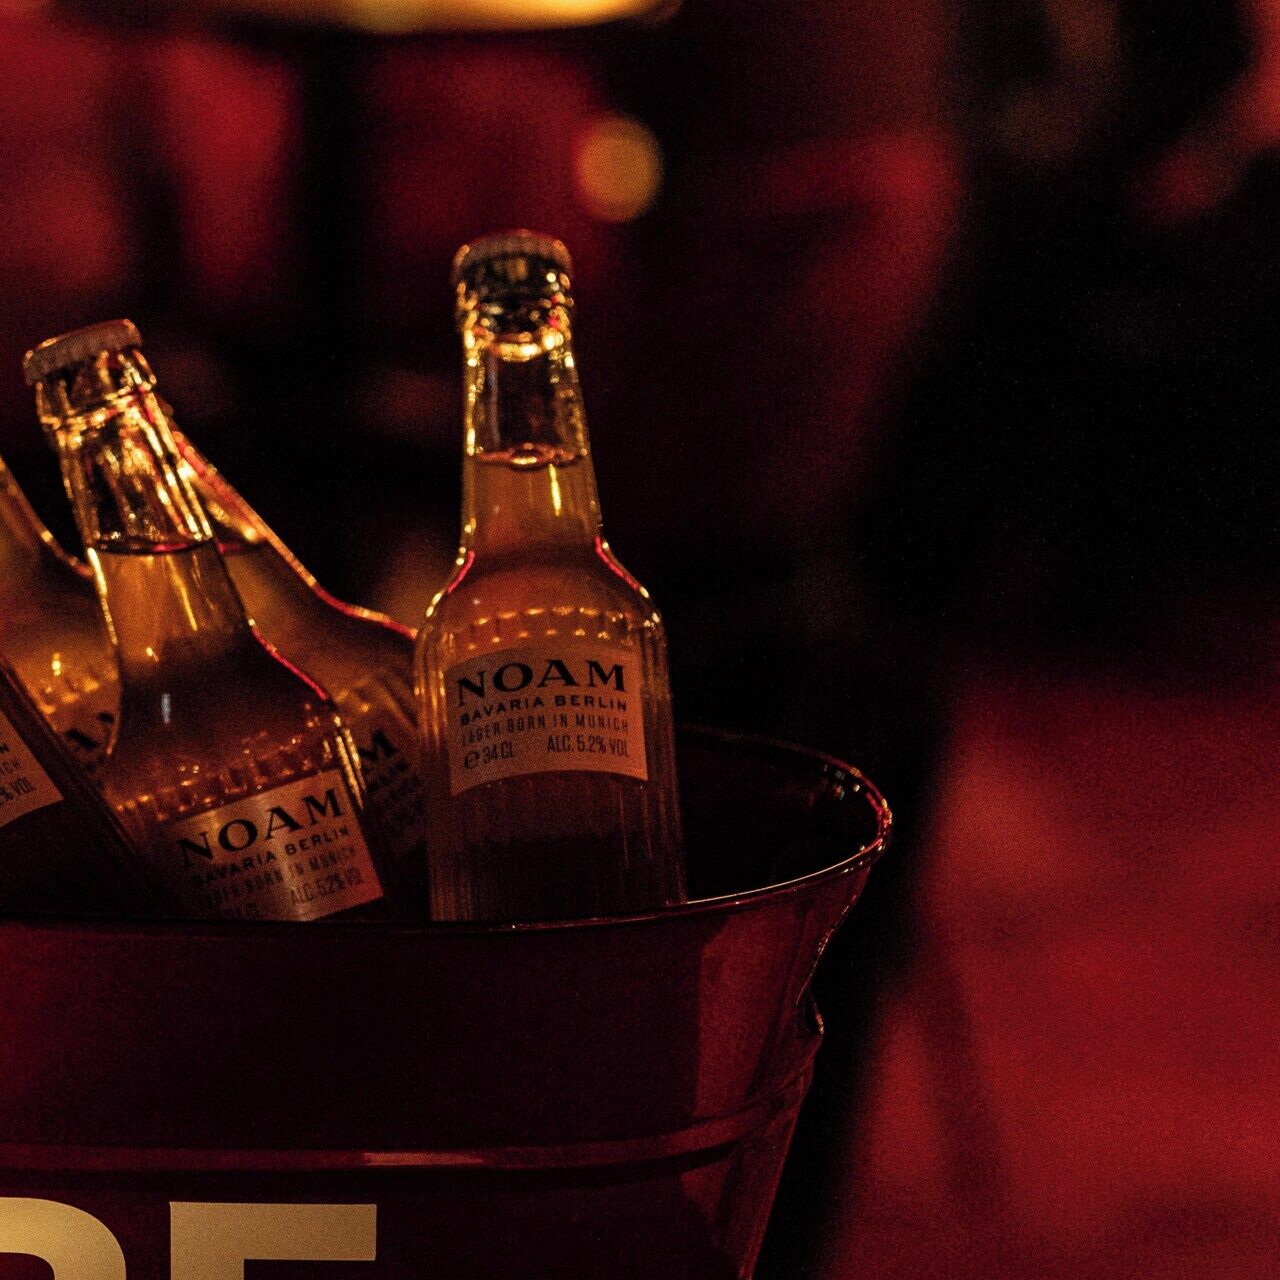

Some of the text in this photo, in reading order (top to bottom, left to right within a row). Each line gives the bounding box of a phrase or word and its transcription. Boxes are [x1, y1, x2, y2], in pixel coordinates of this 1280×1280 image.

[457, 660, 624, 707] NOAM
[460, 695, 627, 725] BAVARIA BERLIN
[508, 715, 545, 732] BORN
[553, 714, 568, 727] IN
[576, 714, 628, 732] MUNICH
[177, 789, 343, 867] NOAM
[284, 825, 349, 856] BERLIN
